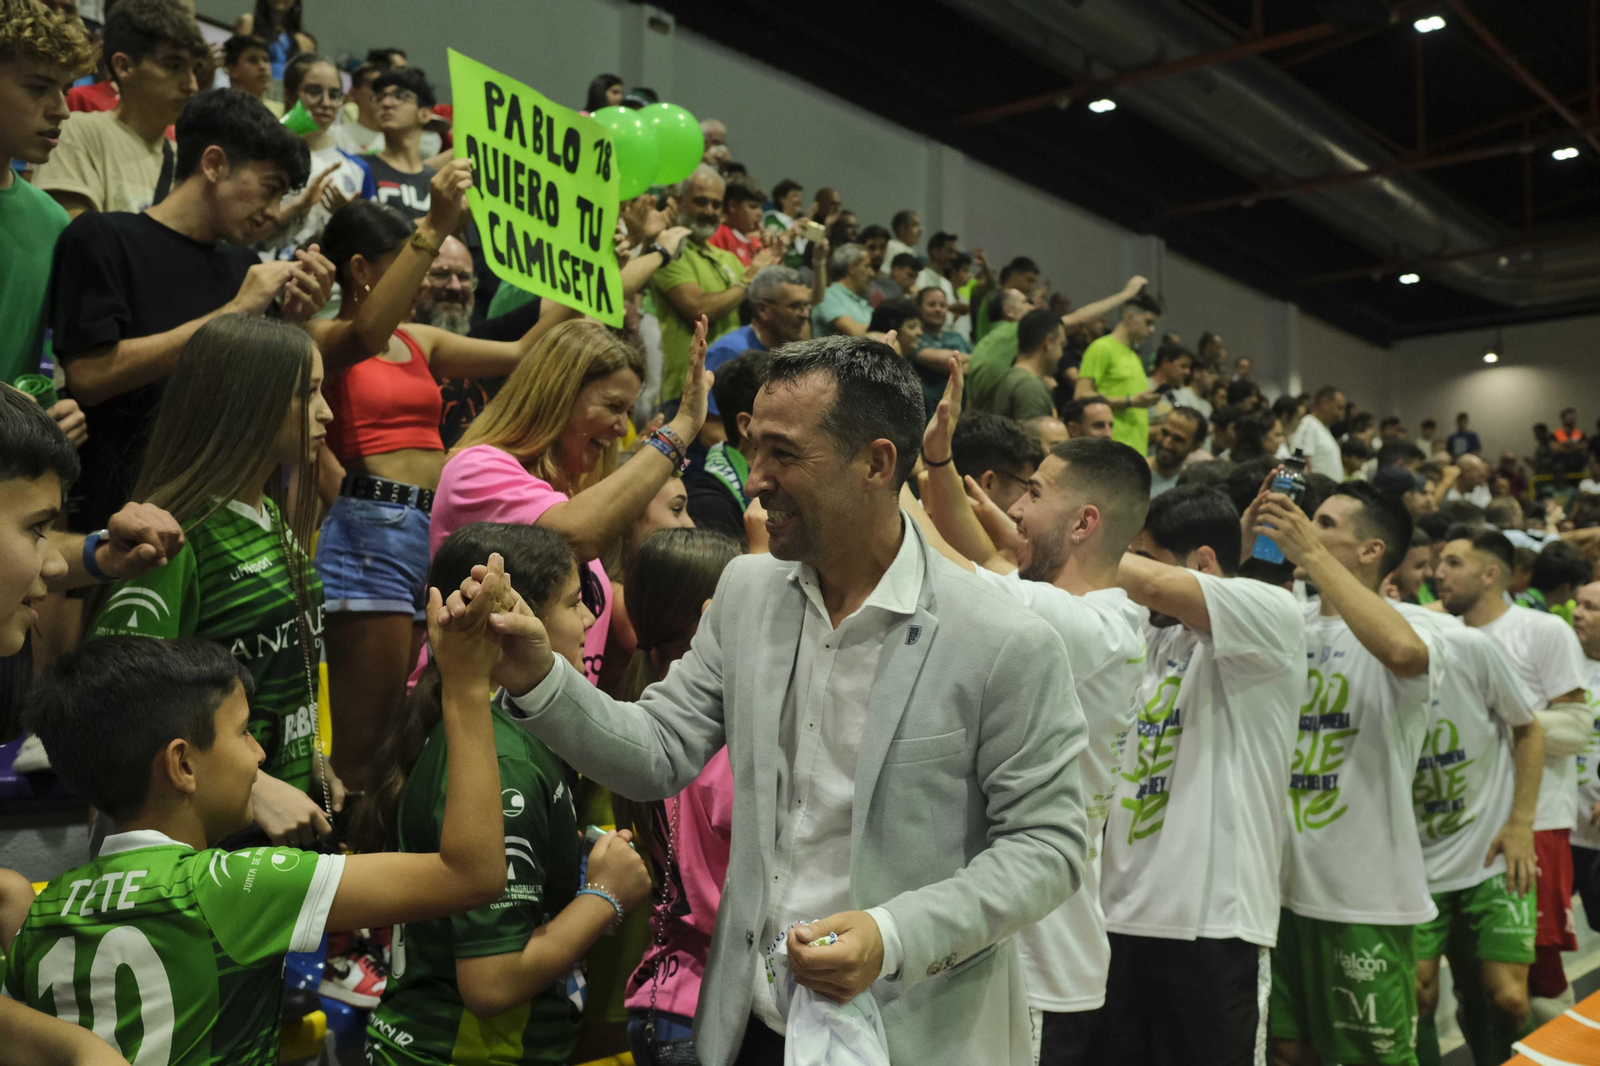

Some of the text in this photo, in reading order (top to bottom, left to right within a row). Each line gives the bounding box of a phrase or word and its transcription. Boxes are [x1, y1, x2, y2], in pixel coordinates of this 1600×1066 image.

[484, 80, 581, 175] PABLO
[466, 134, 603, 252] QUIERO TU
[488, 211, 614, 314] CAMISETA
[60, 869, 148, 917] TETE
[243, 868, 258, 893] JUNTA
[38, 924, 176, 1066] 10
